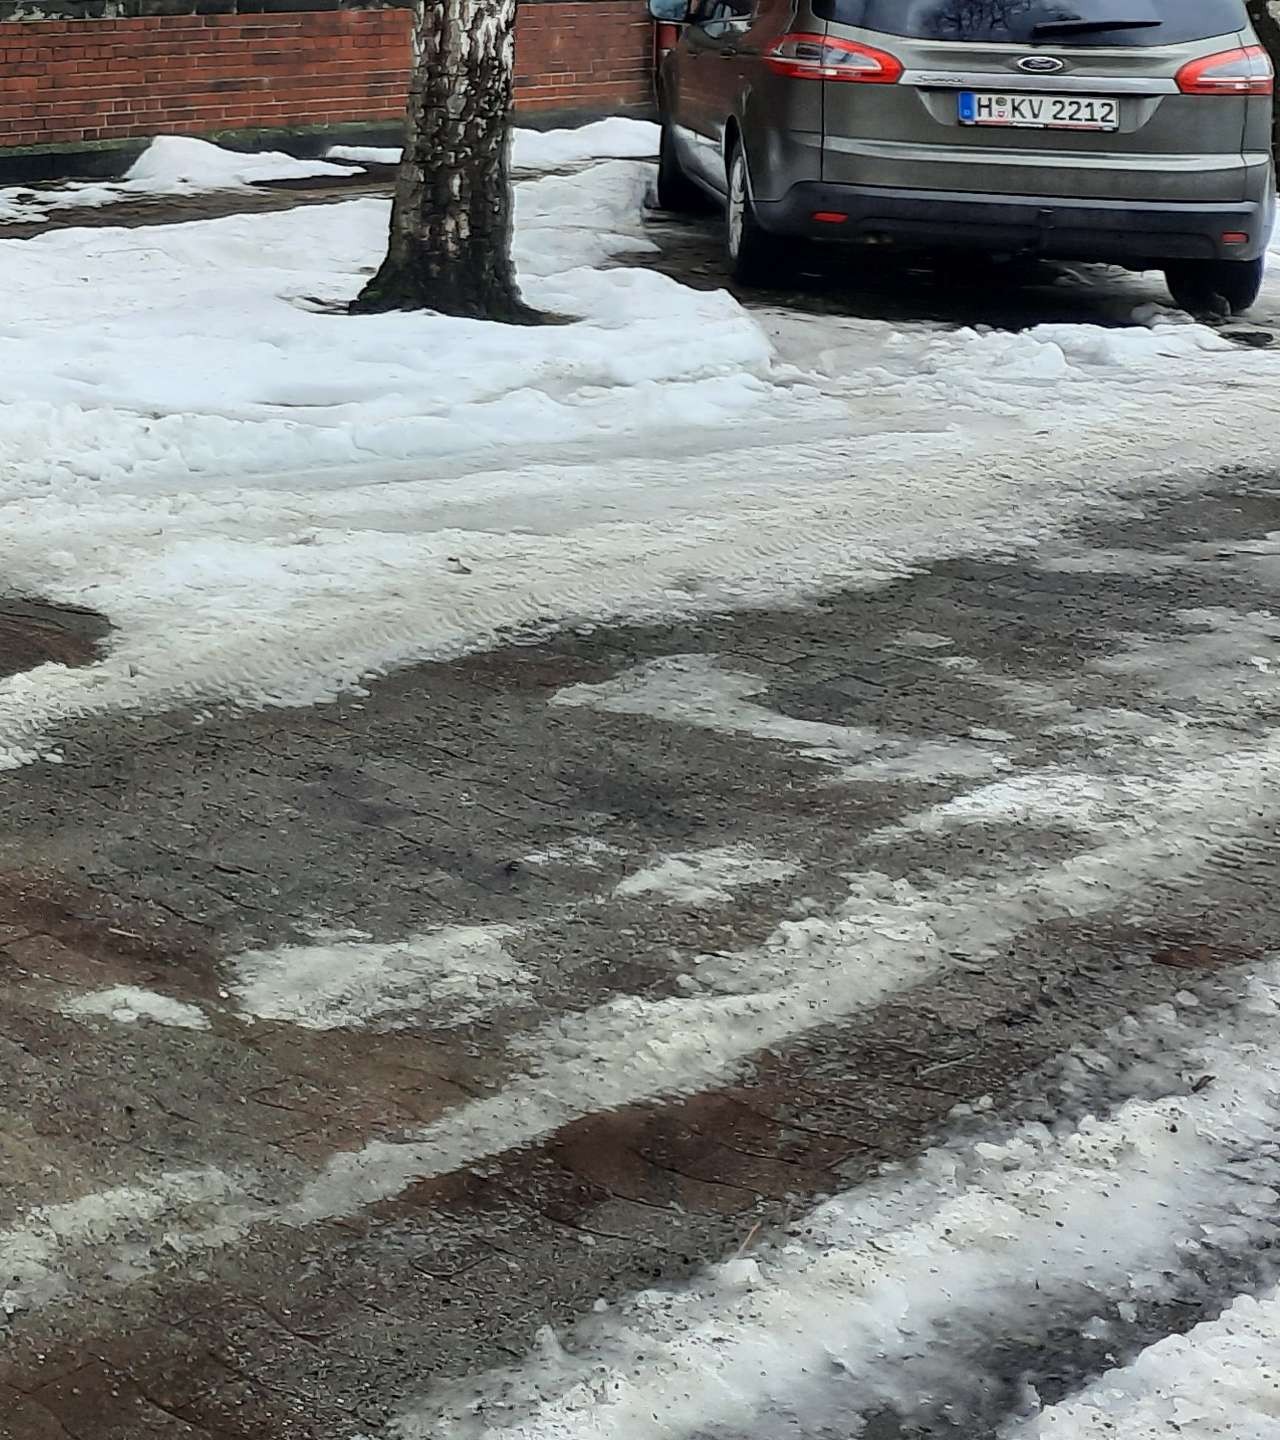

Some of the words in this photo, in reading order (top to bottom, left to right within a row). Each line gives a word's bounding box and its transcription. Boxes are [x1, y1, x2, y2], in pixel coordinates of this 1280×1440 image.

[977, 96, 992, 118] H
[1011, 98, 1043, 119] KV
[1052, 100, 1115, 123] 2212
